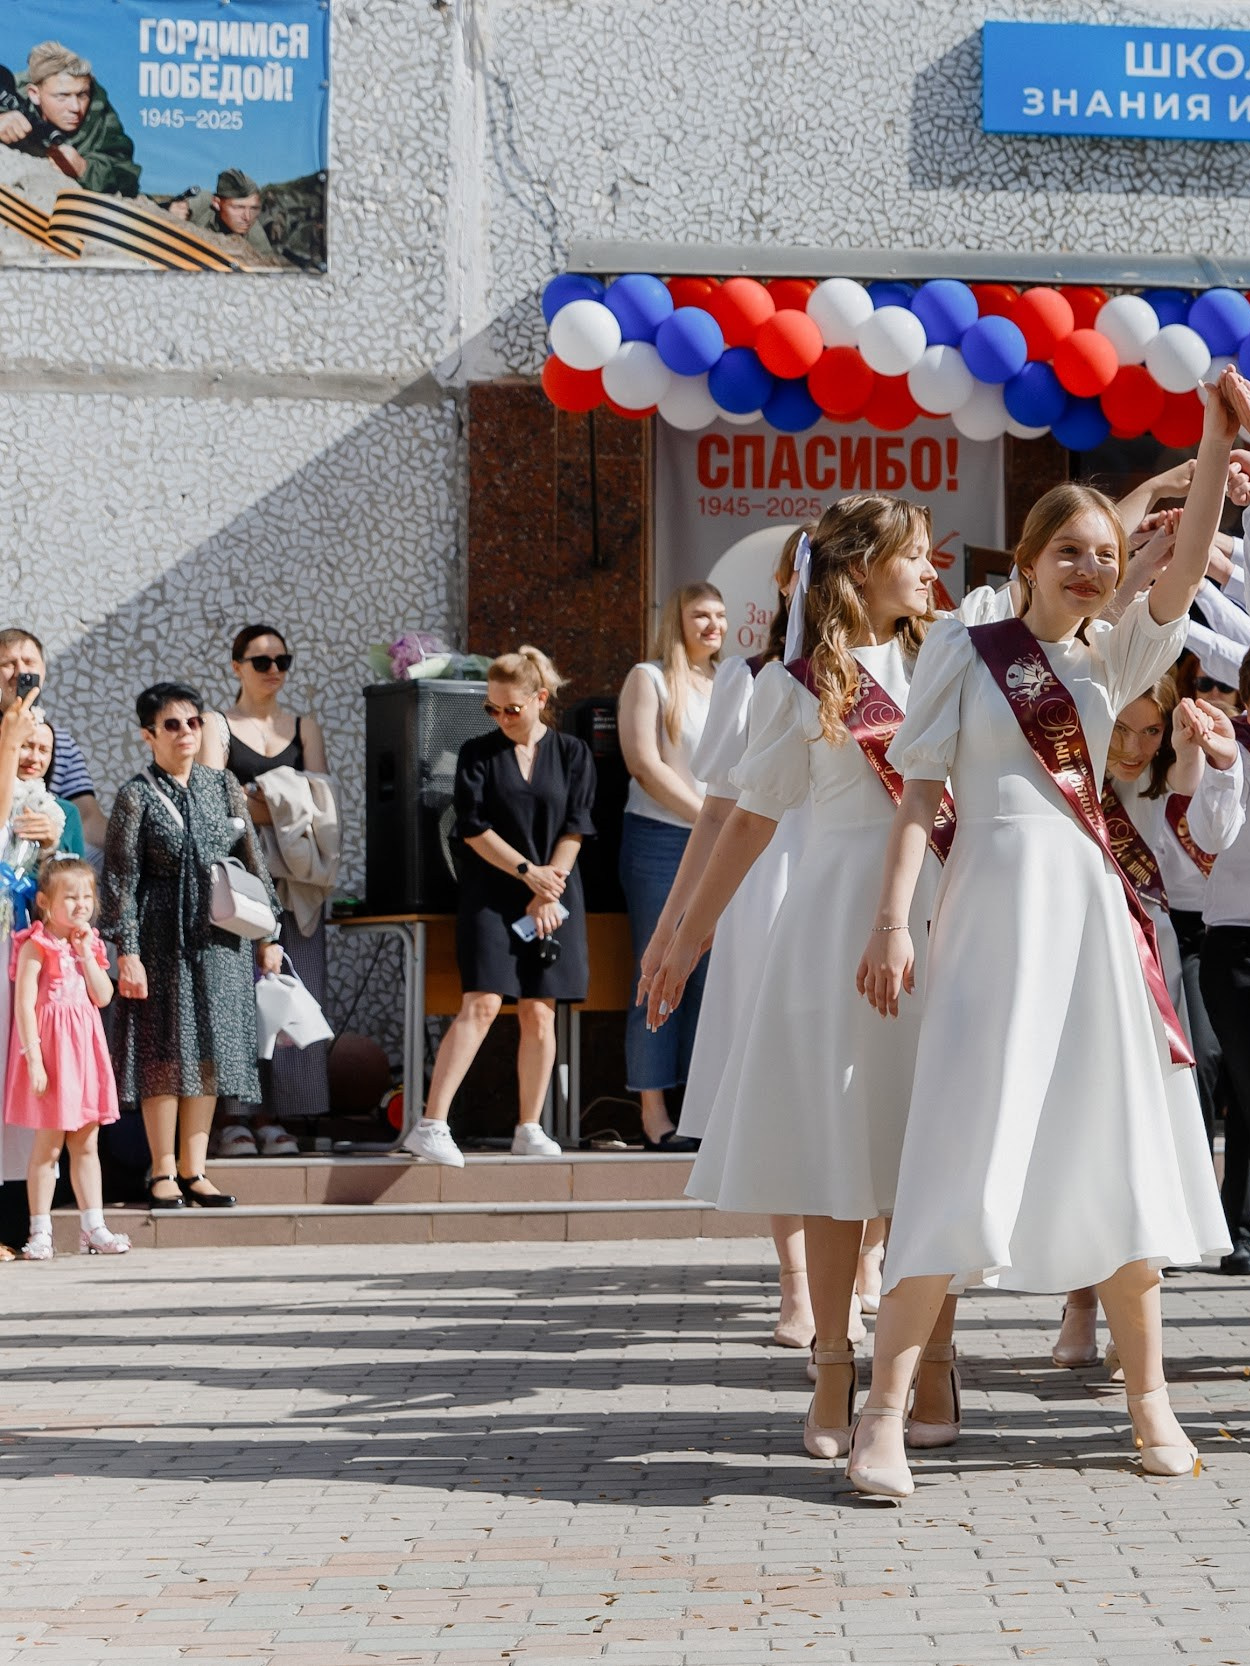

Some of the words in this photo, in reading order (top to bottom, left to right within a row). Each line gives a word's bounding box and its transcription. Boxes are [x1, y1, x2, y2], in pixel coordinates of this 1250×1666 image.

[139, 18, 310, 62] ГОРДИМСЯ
[139, 61, 294, 106] ПОБЕДОЙ!
[1022, 87, 1211, 122] ЗНАНИЯ
[697, 433, 960, 493] СПАСИБО!
